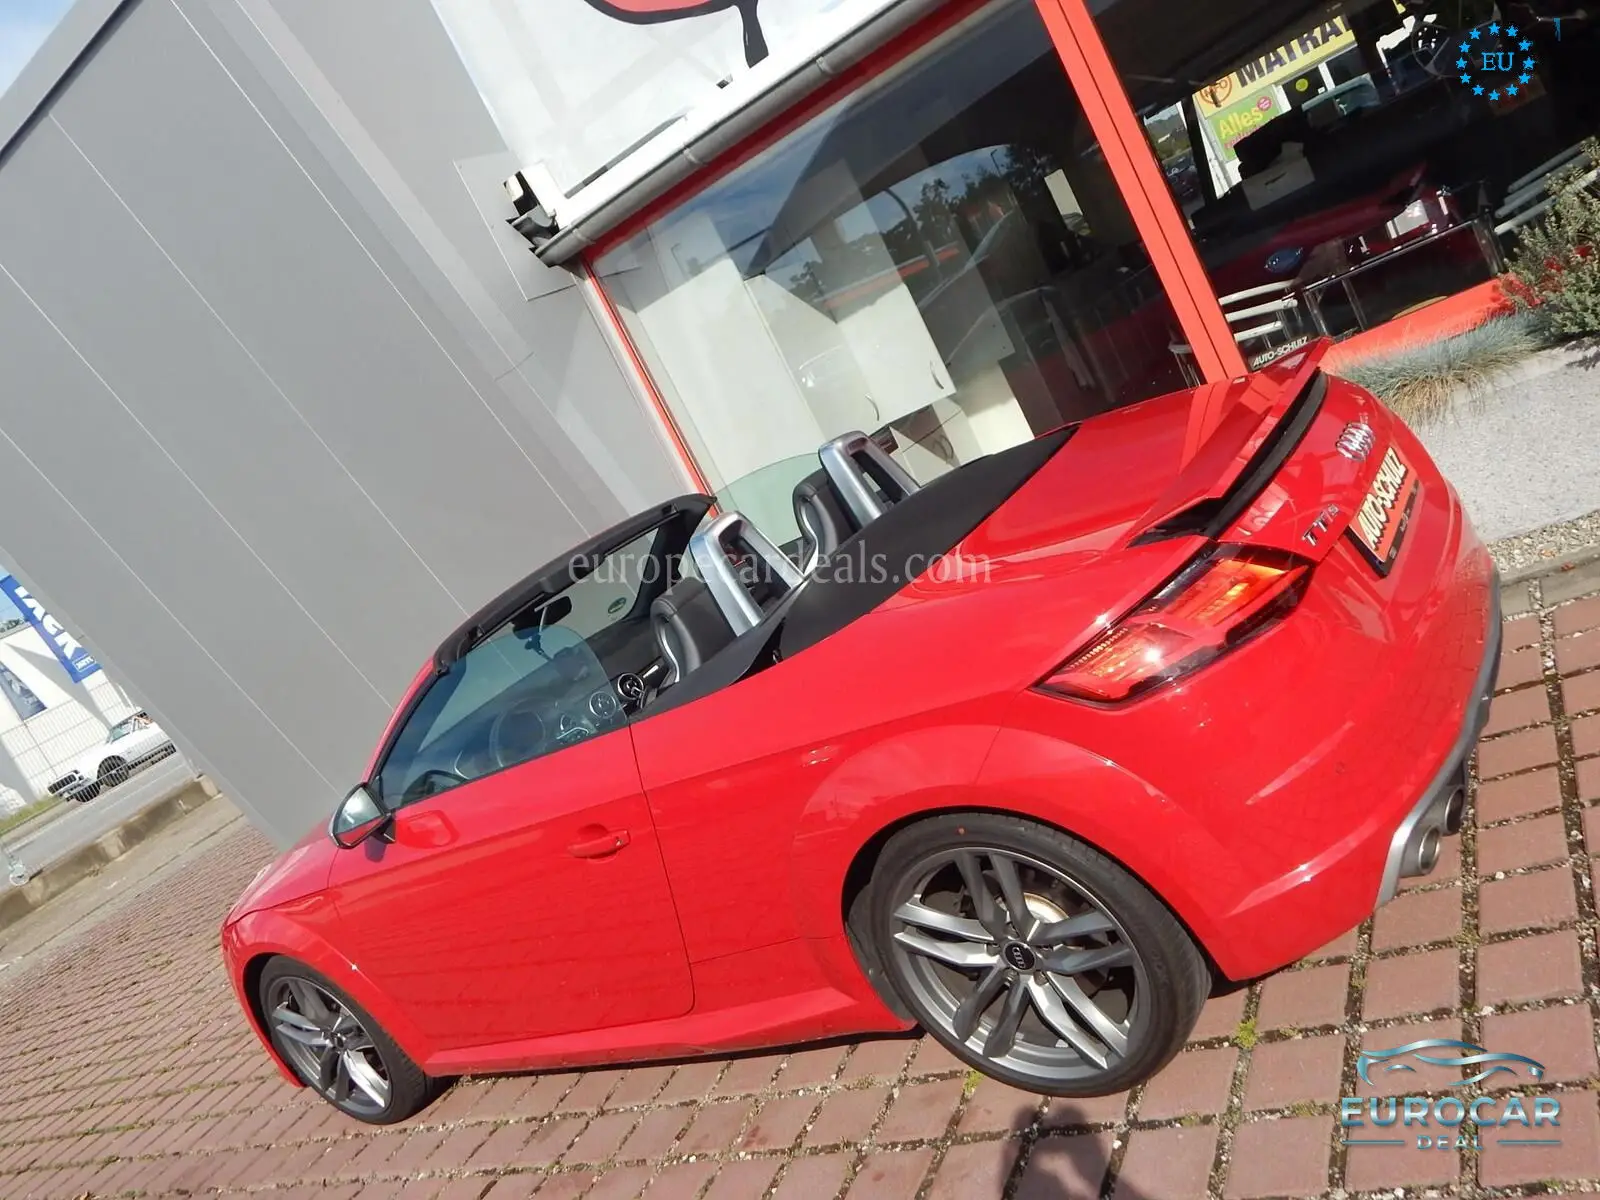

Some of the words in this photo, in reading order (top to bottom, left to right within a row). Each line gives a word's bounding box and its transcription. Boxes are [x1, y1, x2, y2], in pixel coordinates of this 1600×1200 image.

[1219, 107, 1263, 140] Alles
[1253, 336, 1308, 367] AUTO-SCHULZ
[1358, 447, 1406, 550] AUTO-SCHULZ
